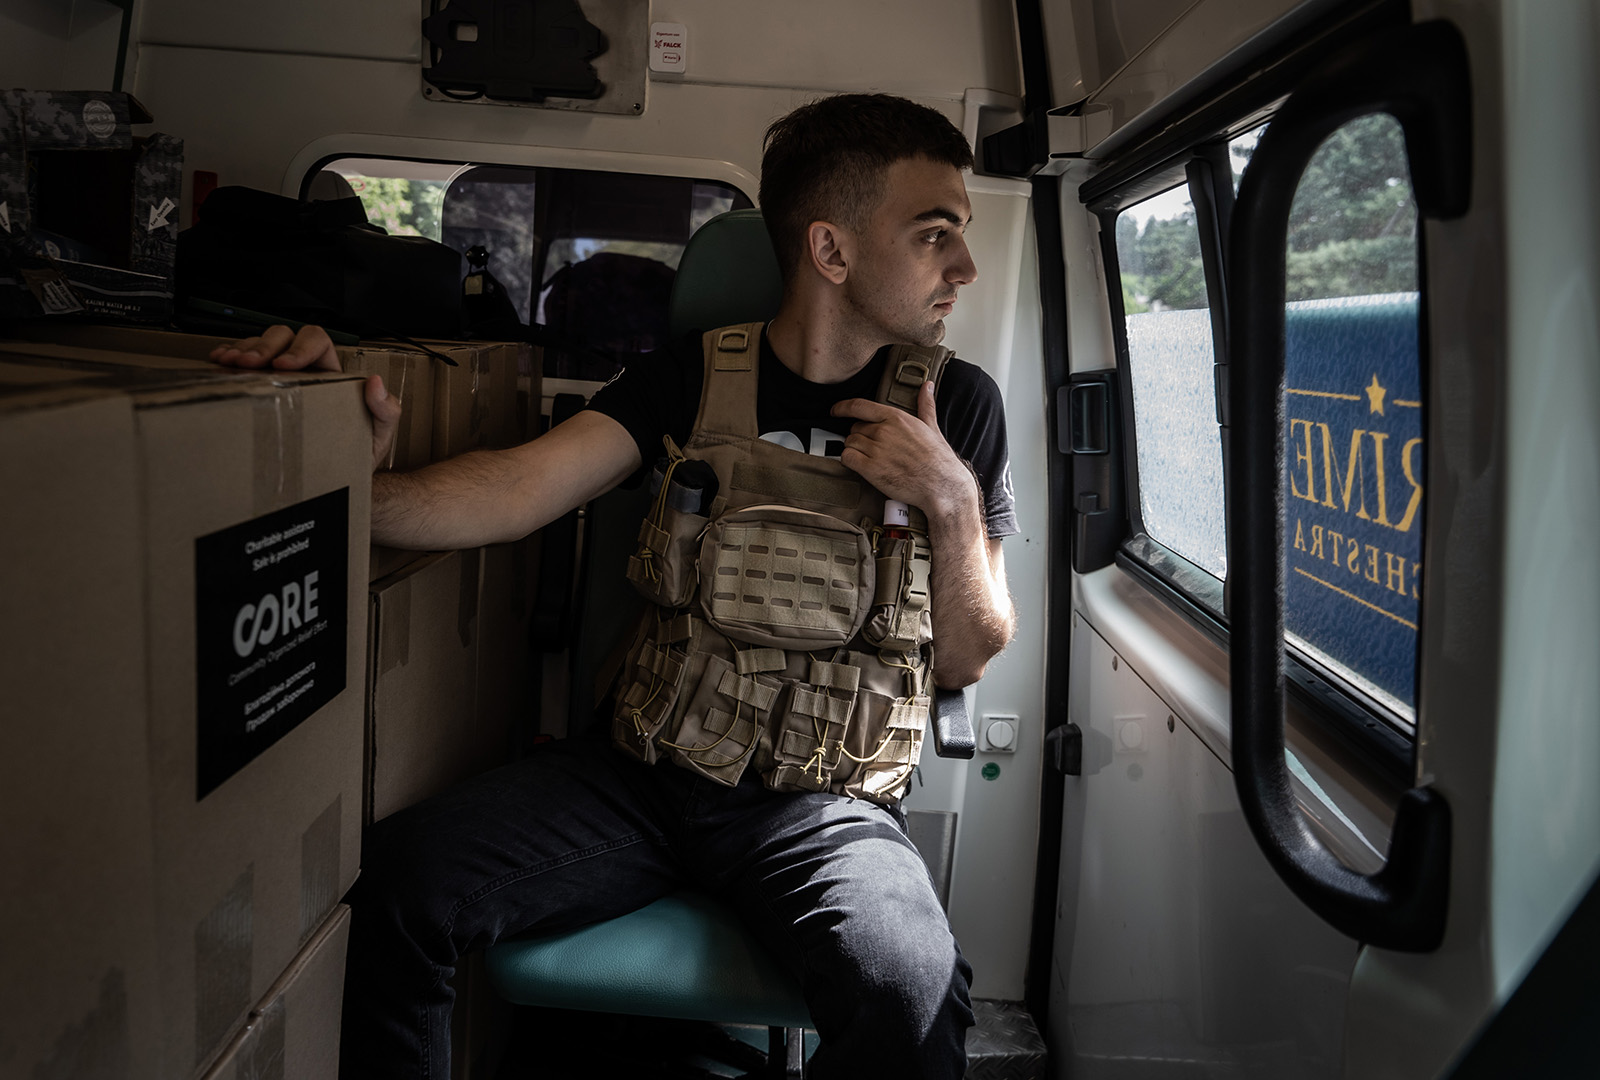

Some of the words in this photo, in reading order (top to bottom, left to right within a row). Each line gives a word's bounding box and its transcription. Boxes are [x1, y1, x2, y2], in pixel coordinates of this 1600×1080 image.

[244, 532, 282, 554] Charitable
[283, 519, 315, 539] assistance
[252, 556, 269, 571] Sale
[276, 537, 310, 563] prohibited
[233, 569, 319, 657] CORE
[227, 658, 266, 687] Community
[266, 636, 298, 663] Organized
[298, 627, 313, 643] Relief
[313, 619, 328, 636] Effort
[285, 661, 316, 688] допомога
[245, 706, 276, 733] Продаж
[276, 679, 314, 712] заборонено
